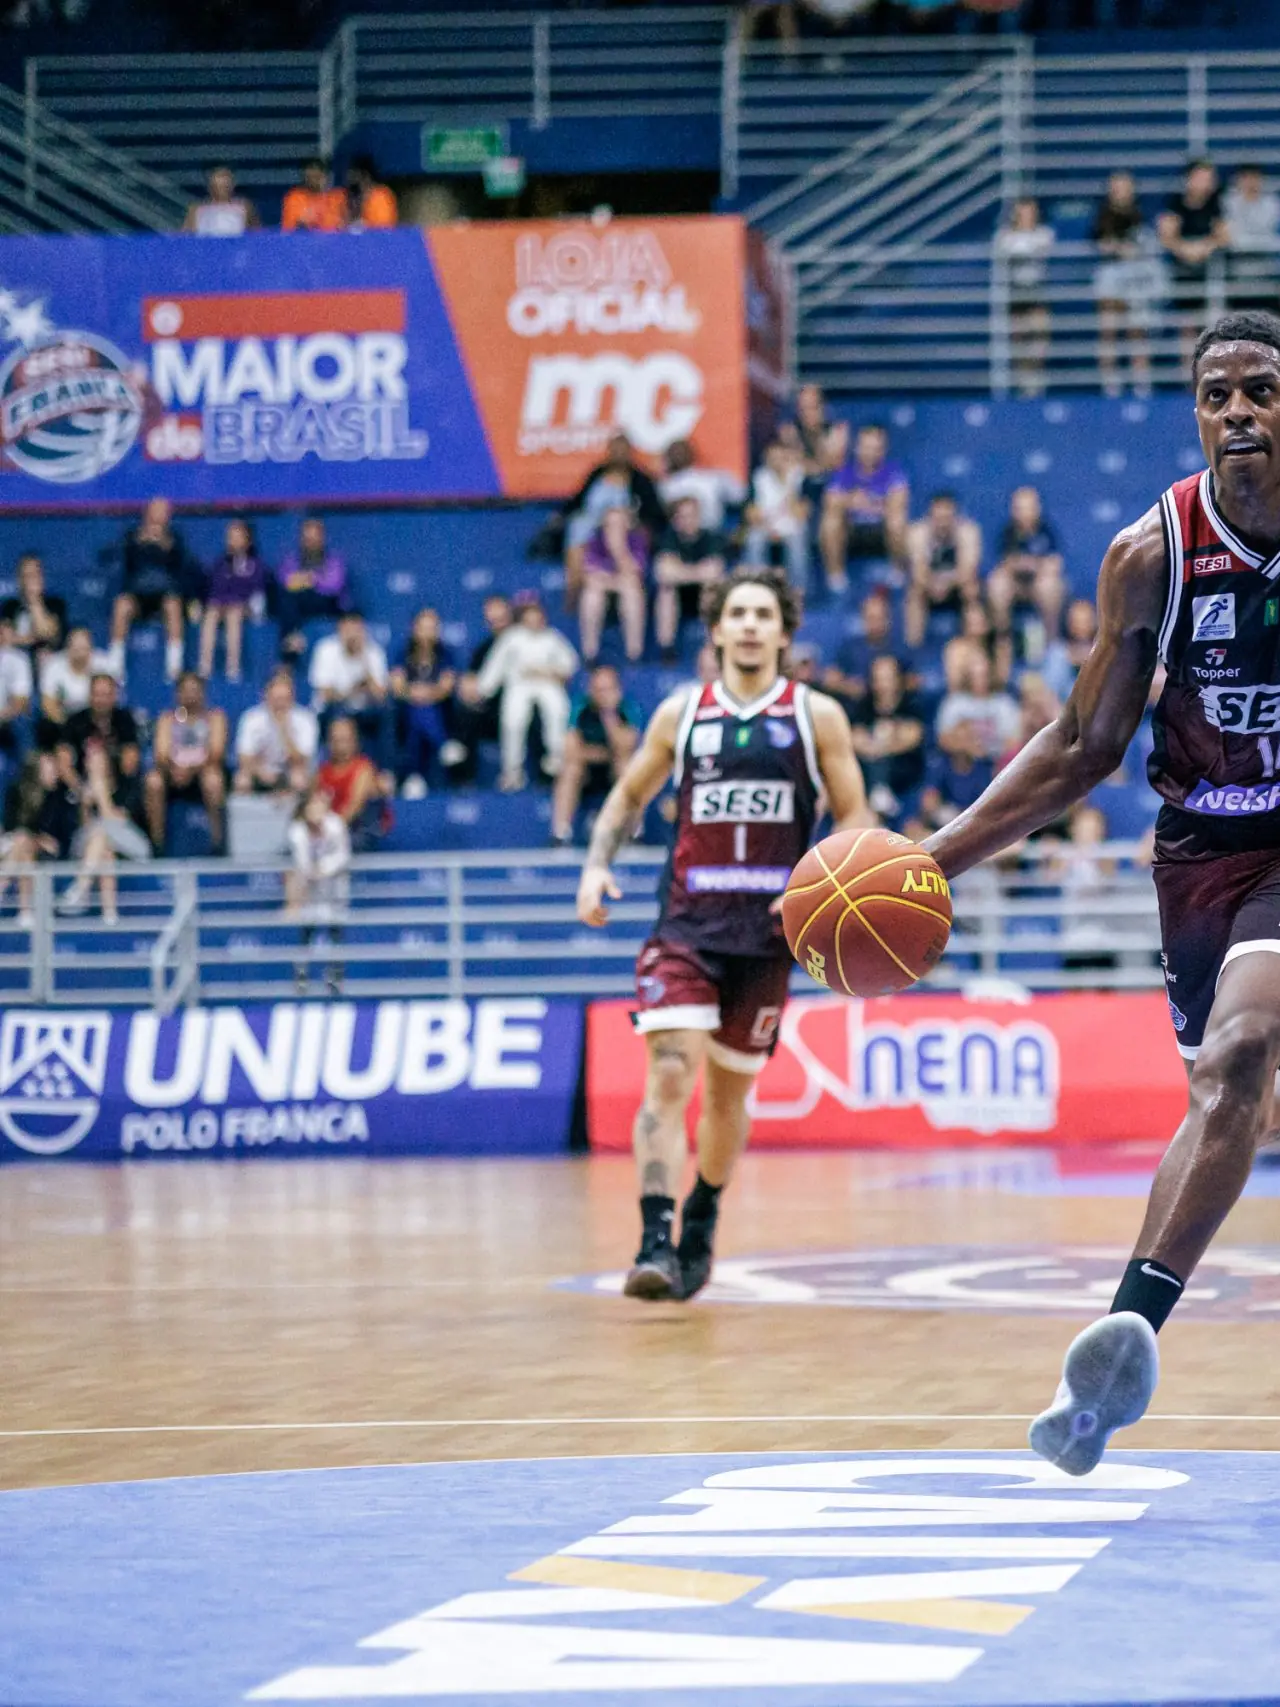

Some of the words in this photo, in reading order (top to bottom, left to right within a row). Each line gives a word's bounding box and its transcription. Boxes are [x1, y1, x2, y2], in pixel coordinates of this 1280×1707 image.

[514, 231, 673, 292] LOJA
[507, 285, 699, 336] OFICIAL
[152, 331, 408, 405] MAIOR
[146, 416, 201, 460] do
[203, 402, 429, 463] BRASIL
[1195, 556, 1228, 571] SESI
[1192, 666, 1240, 681] Topper
[703, 789, 783, 817] SESI
[124, 1000, 547, 1107] UNIUBE
[122, 1112, 219, 1151] POLO
[222, 1104, 369, 1145] FRANCA
[243, 1458, 1191, 1701] CAIXA
